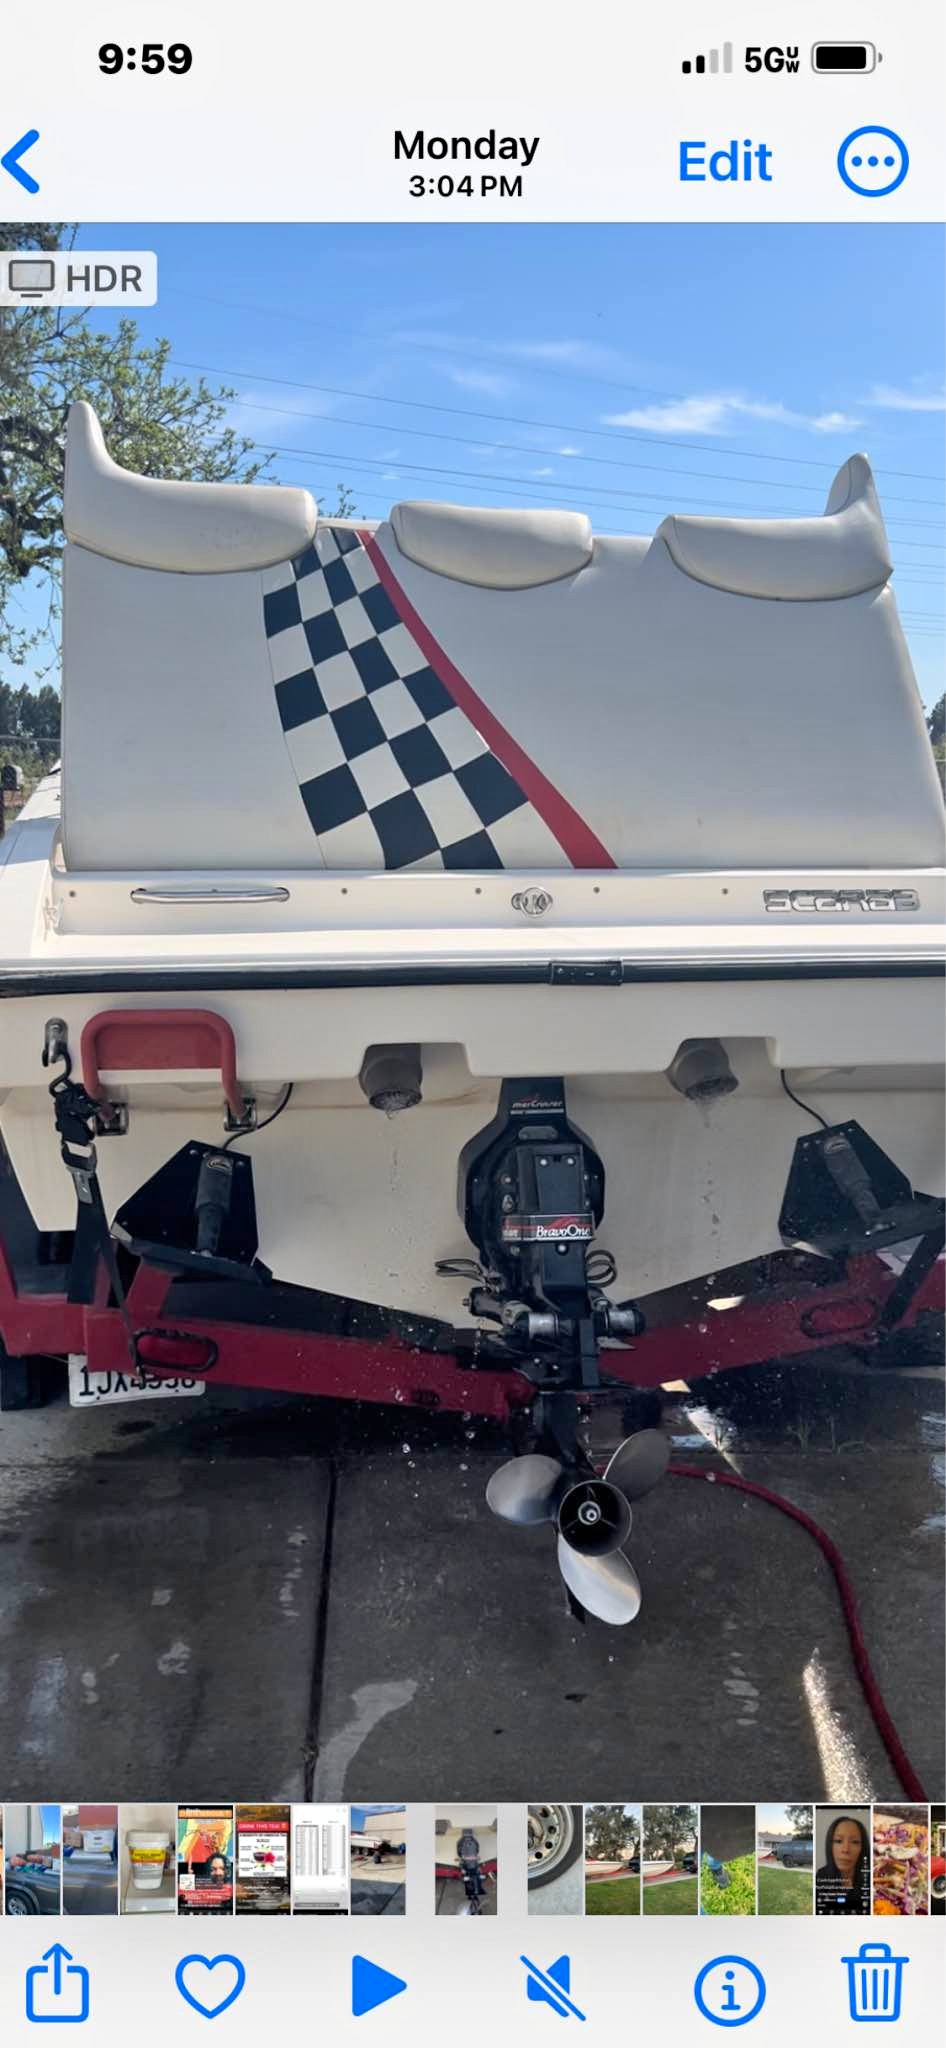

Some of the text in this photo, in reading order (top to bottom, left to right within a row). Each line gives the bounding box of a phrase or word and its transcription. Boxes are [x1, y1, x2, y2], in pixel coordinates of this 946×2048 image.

[99, 43, 192, 74] 9:59
[394, 129, 540, 165] Monday
[679, 139, 773, 181] Edit
[409, 175, 523, 198] 3:04 PM
[67, 265, 142, 292] HDR
